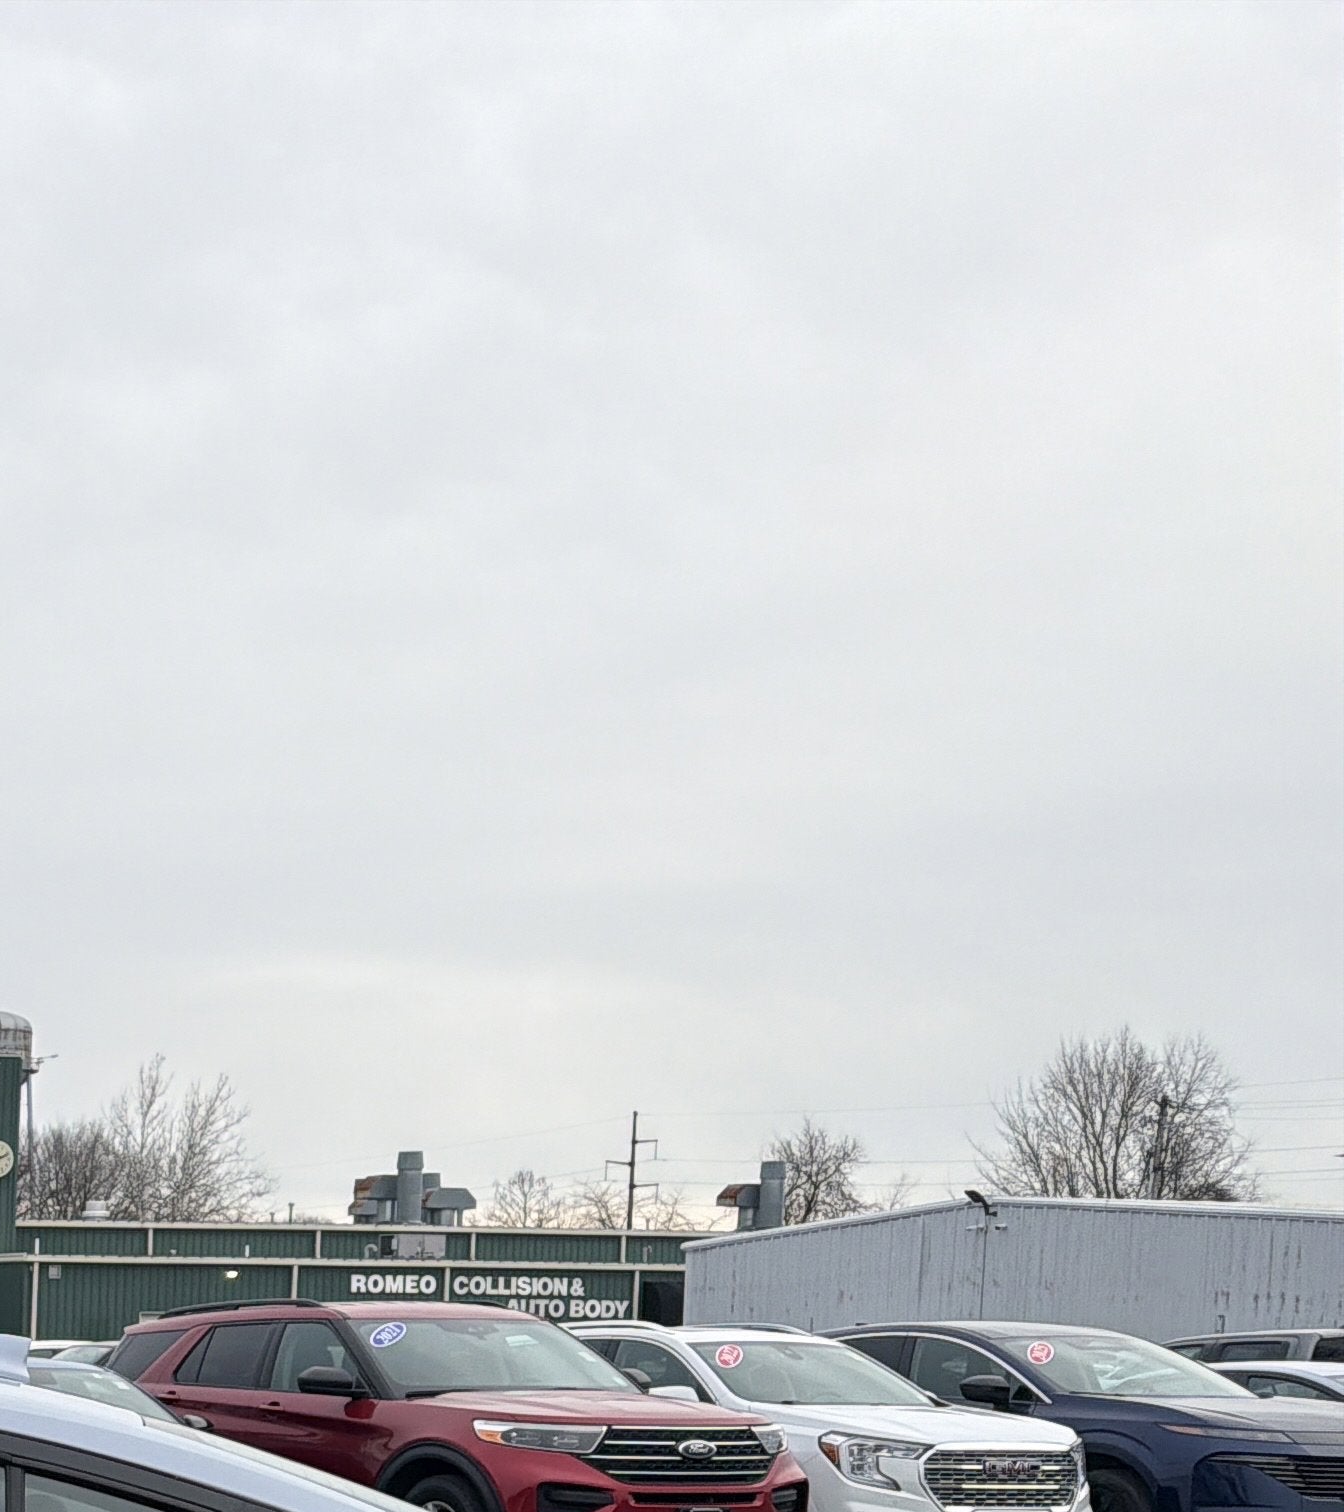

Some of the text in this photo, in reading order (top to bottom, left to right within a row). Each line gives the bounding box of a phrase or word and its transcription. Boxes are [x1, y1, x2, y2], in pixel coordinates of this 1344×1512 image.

[350, 1274, 437, 1295] ROMEO
[507, 1298, 630, 1319] AUTO BODY
[983, 1459, 1041, 1474] GMC
